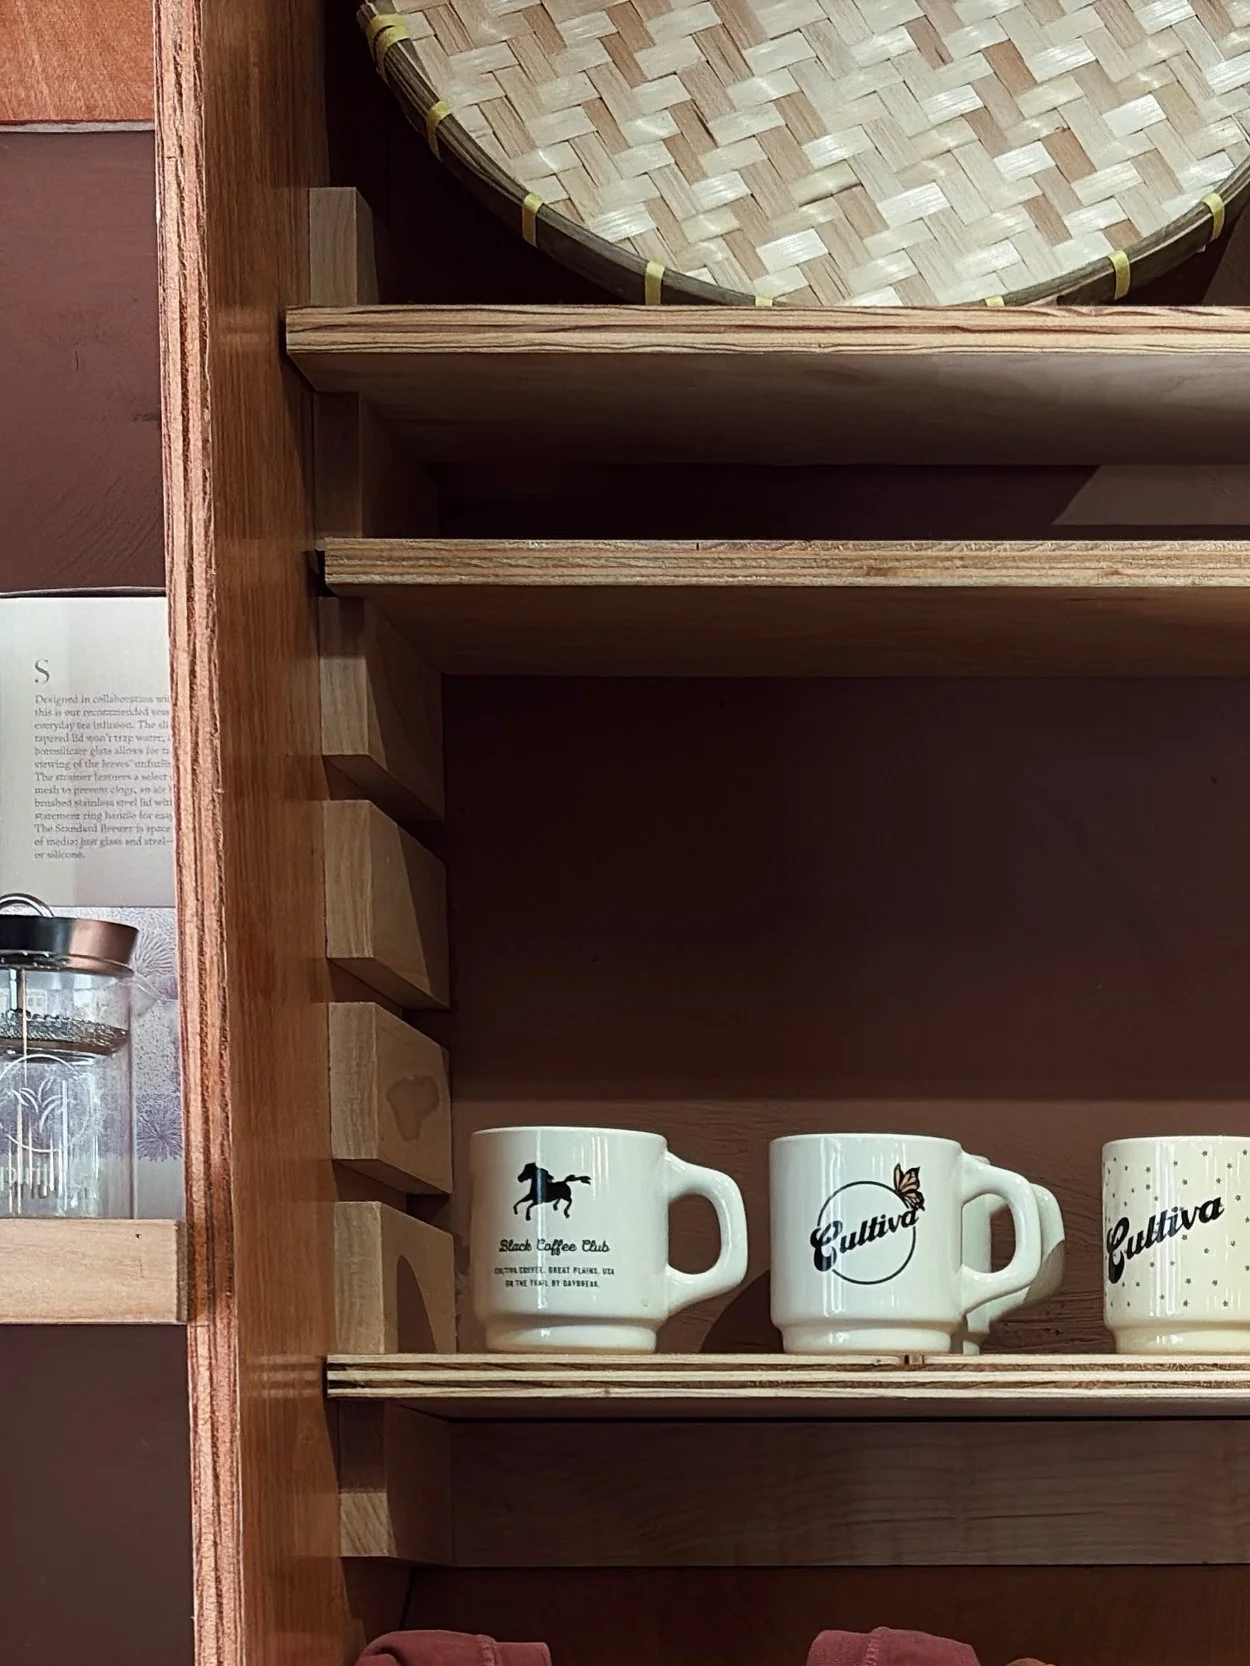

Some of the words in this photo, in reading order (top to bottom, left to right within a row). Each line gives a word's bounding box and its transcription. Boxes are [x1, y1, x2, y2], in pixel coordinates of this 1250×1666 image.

[34, 658, 50, 684] S
[498, 1238, 532, 1253] Black
[536, 1238, 577, 1256] Coffee
[581, 1239, 610, 1253] Club
[810, 1209, 919, 1272] Cultiva
[1106, 1196, 1225, 1284] Cultiva
